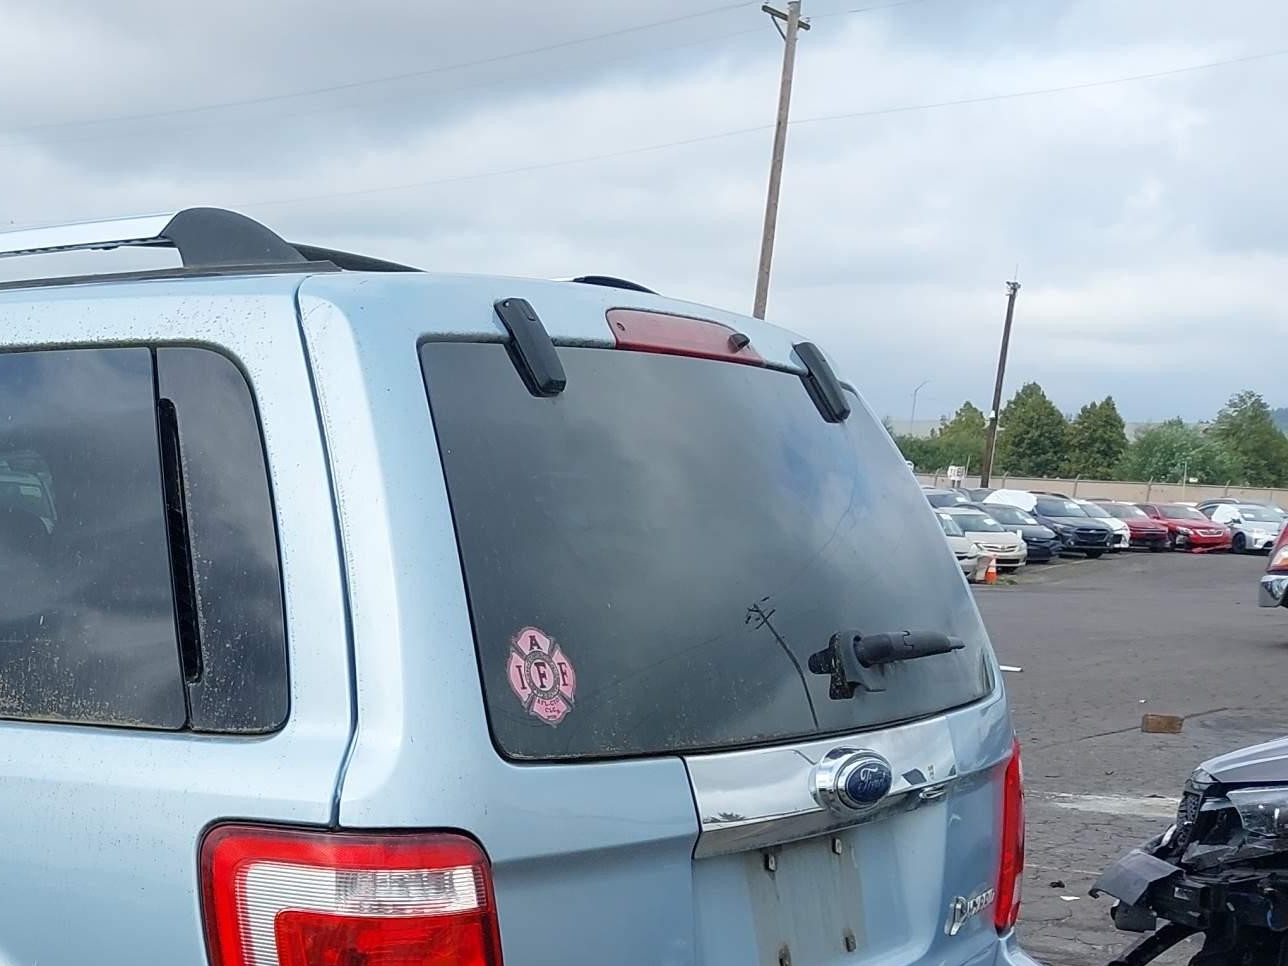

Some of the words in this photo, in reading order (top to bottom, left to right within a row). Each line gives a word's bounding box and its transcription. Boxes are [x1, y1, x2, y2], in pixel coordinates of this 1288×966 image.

[528, 634, 543, 651] A
[515, 664, 528, 690] I
[533, 661, 548, 689] F
[556, 661, 569, 687] F
[856, 766, 887, 794] Ford
